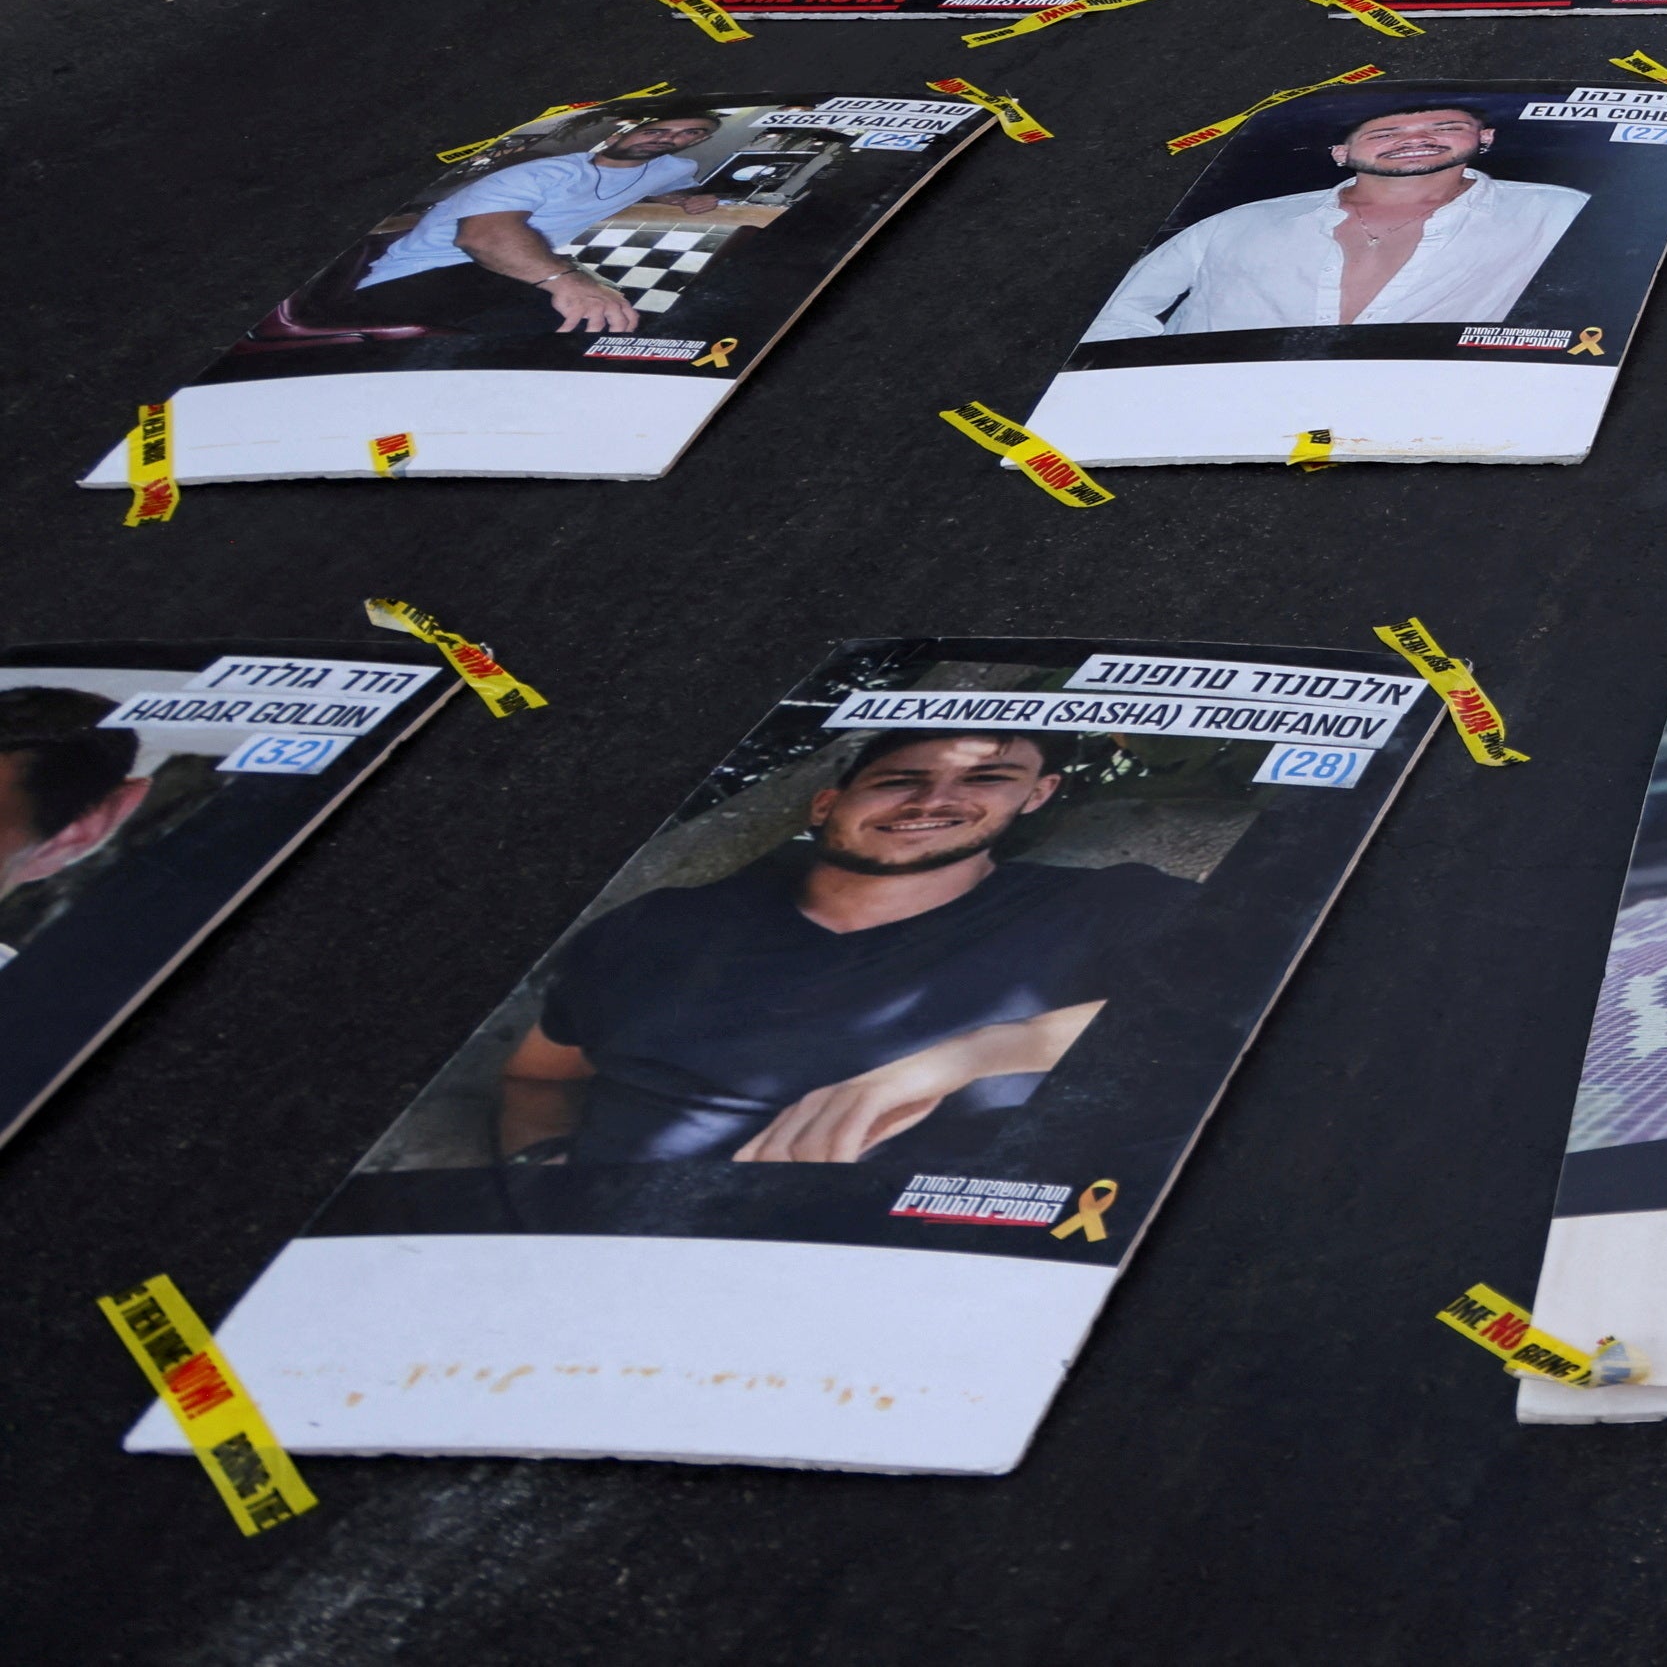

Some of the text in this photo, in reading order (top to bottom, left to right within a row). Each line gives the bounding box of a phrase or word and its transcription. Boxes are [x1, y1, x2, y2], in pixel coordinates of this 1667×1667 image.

[824, 99, 976, 118] שגב חלפון
[1528, 105, 1599, 120] ELIYA
[1577, 89, 1626, 105] כהן
[761, 112, 954, 134] SEGEV KALFON
[1025, 450, 1081, 491] NOW!
[206, 662, 420, 695] הדר גולדין
[1084, 660, 1414, 707] אלכסנדר טרופנוב
[121, 698, 382, 730] HADAR GOLDIN
[842, 697, 1389, 742] ALEXANDER (SASHA) TROUFANOV
[237, 734, 335, 773] (32)
[1269, 748, 1359, 786] (28)
[1510, 1343, 1582, 1380] BRING
